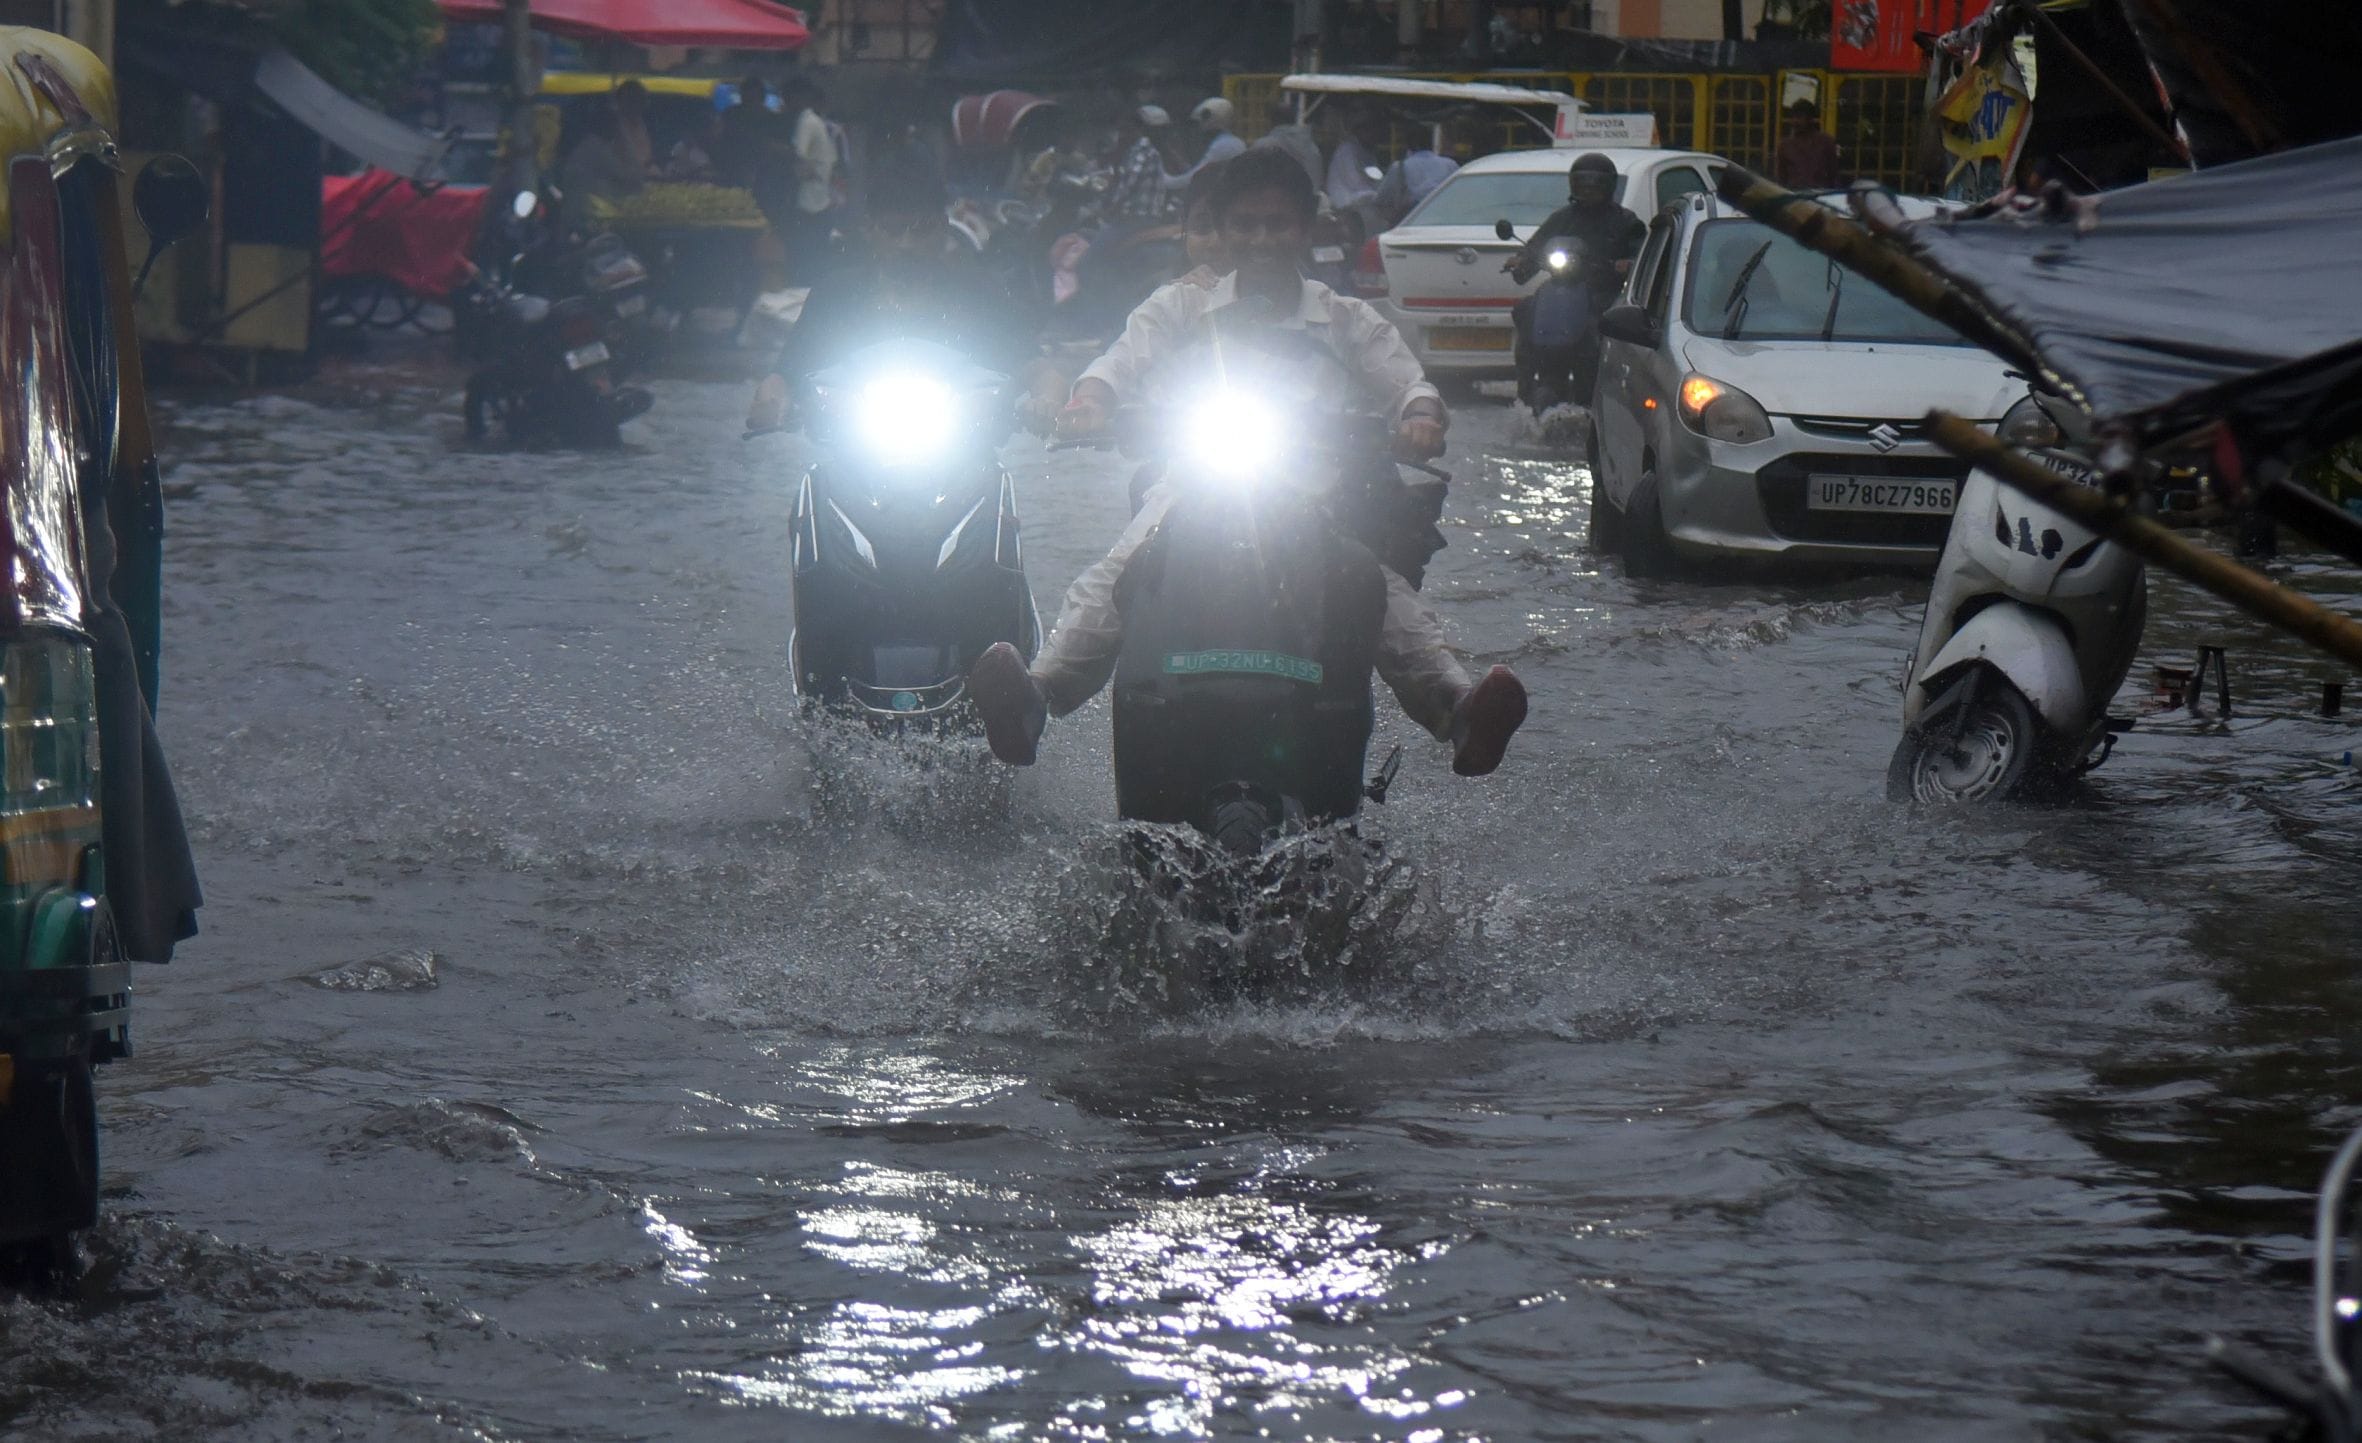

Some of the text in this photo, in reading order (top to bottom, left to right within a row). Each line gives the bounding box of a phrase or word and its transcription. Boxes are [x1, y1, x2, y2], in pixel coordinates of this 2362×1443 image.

[1556, 112, 1574, 140] L
[1584, 118, 1625, 129] TOYOTA
[1822, 482, 1951, 509] UP78CZ7966
